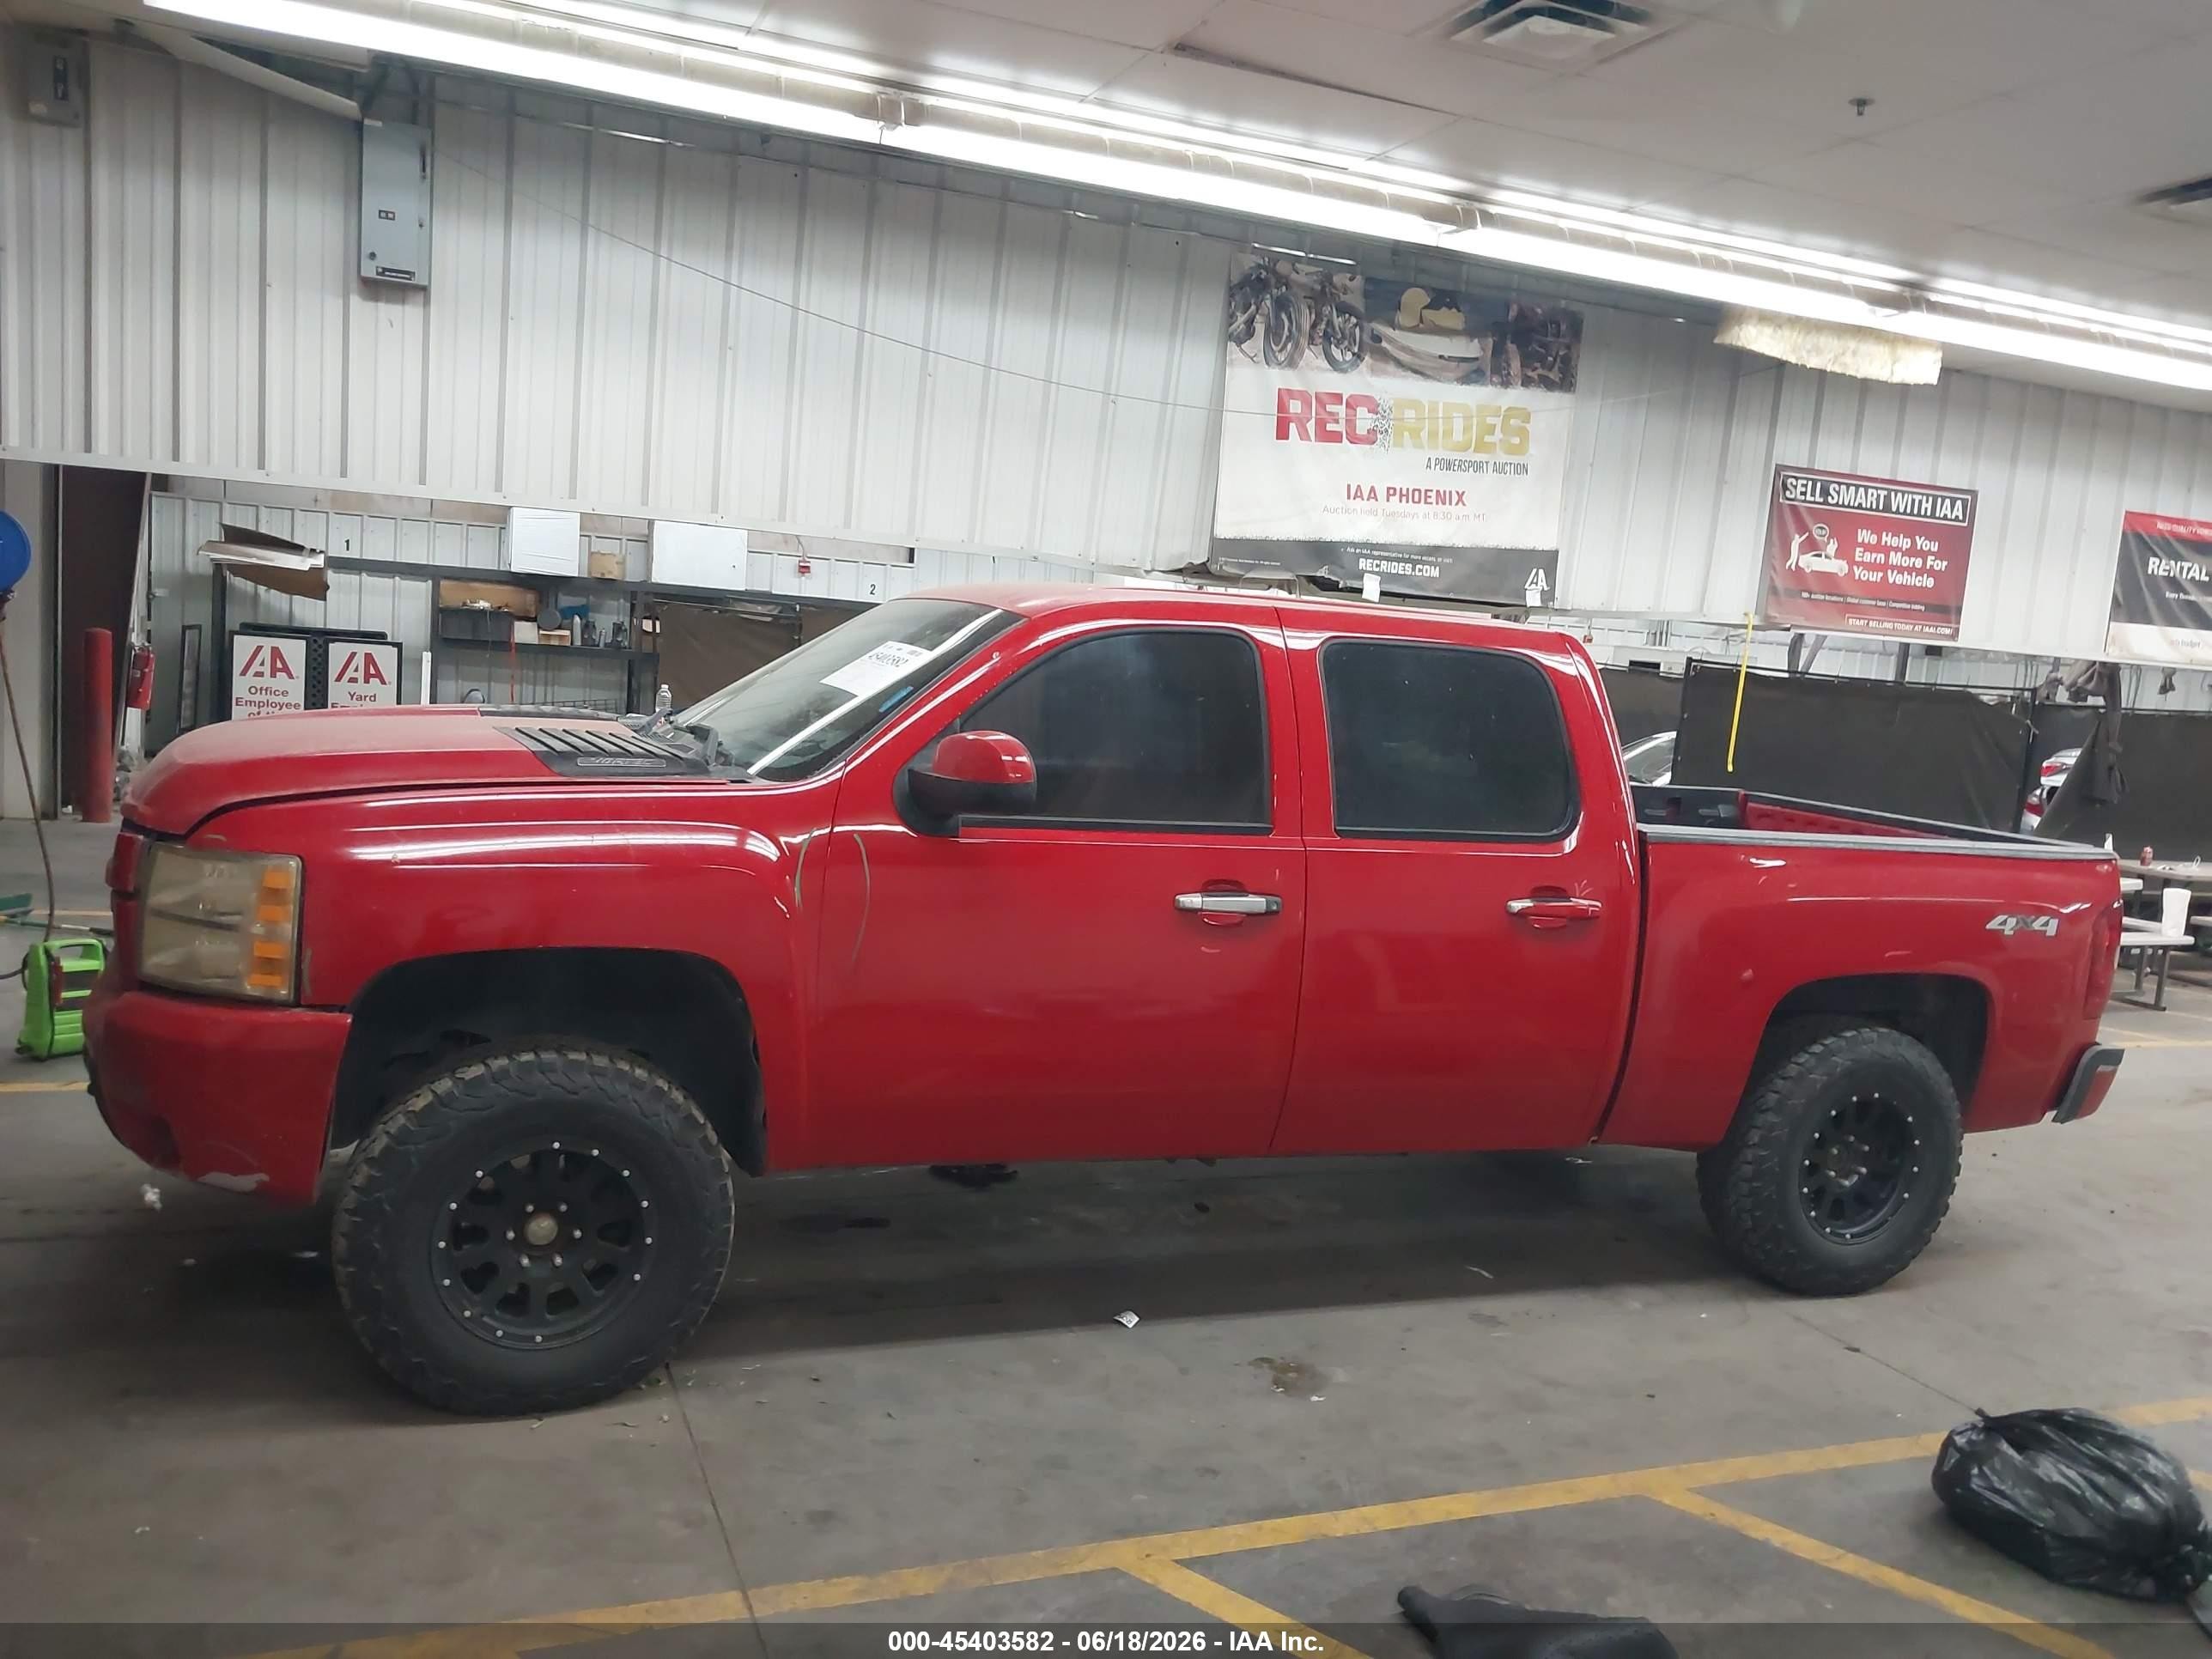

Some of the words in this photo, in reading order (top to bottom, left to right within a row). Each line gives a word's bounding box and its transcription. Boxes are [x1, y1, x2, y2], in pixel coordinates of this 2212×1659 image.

[1276, 387, 1379, 446] REC
[1393, 398, 1532, 456] RIDES
[1425, 457, 1433, 471] A
[1434, 457, 1490, 474] POWERSPORT
[1492, 460, 1528, 477] AUCTION
[1346, 483, 1379, 502] IAA
[1385, 486, 1468, 507] PHOENIX
[1785, 477, 1824, 503] SELL
[1827, 483, 1887, 511] SMART
[1891, 491, 1932, 517] WITH
[1936, 496, 1964, 520] IAA
[1322, 505, 1358, 515] Auction
[1381, 507, 1419, 520] Tuesdays
[344, 538, 350, 551] 1
[1856, 528, 1878, 544] We
[1881, 532, 1911, 552] Help
[1915, 536, 1939, 552] You
[1358, 557, 1440, 578] RECRIDES.COM
[1854, 547, 1885, 564] Earn
[1888, 552, 1923, 569] More
[1925, 555, 1948, 572] For
[2148, 556, 2210, 582] RENTAL
[1853, 565, 1883, 582] Your
[1887, 569, 1935, 588] Vehicle
[869, 583, 876, 596] 2
[1848, 617, 1868, 627] START
[1869, 619, 1893, 629] SELLING
[1893, 622, 1913, 631] TODAY
[1913, 623, 1923, 633] AT
[247, 684, 289, 698] Office
[347, 690, 377, 702] Yard
[234, 696, 301, 713] Employee
